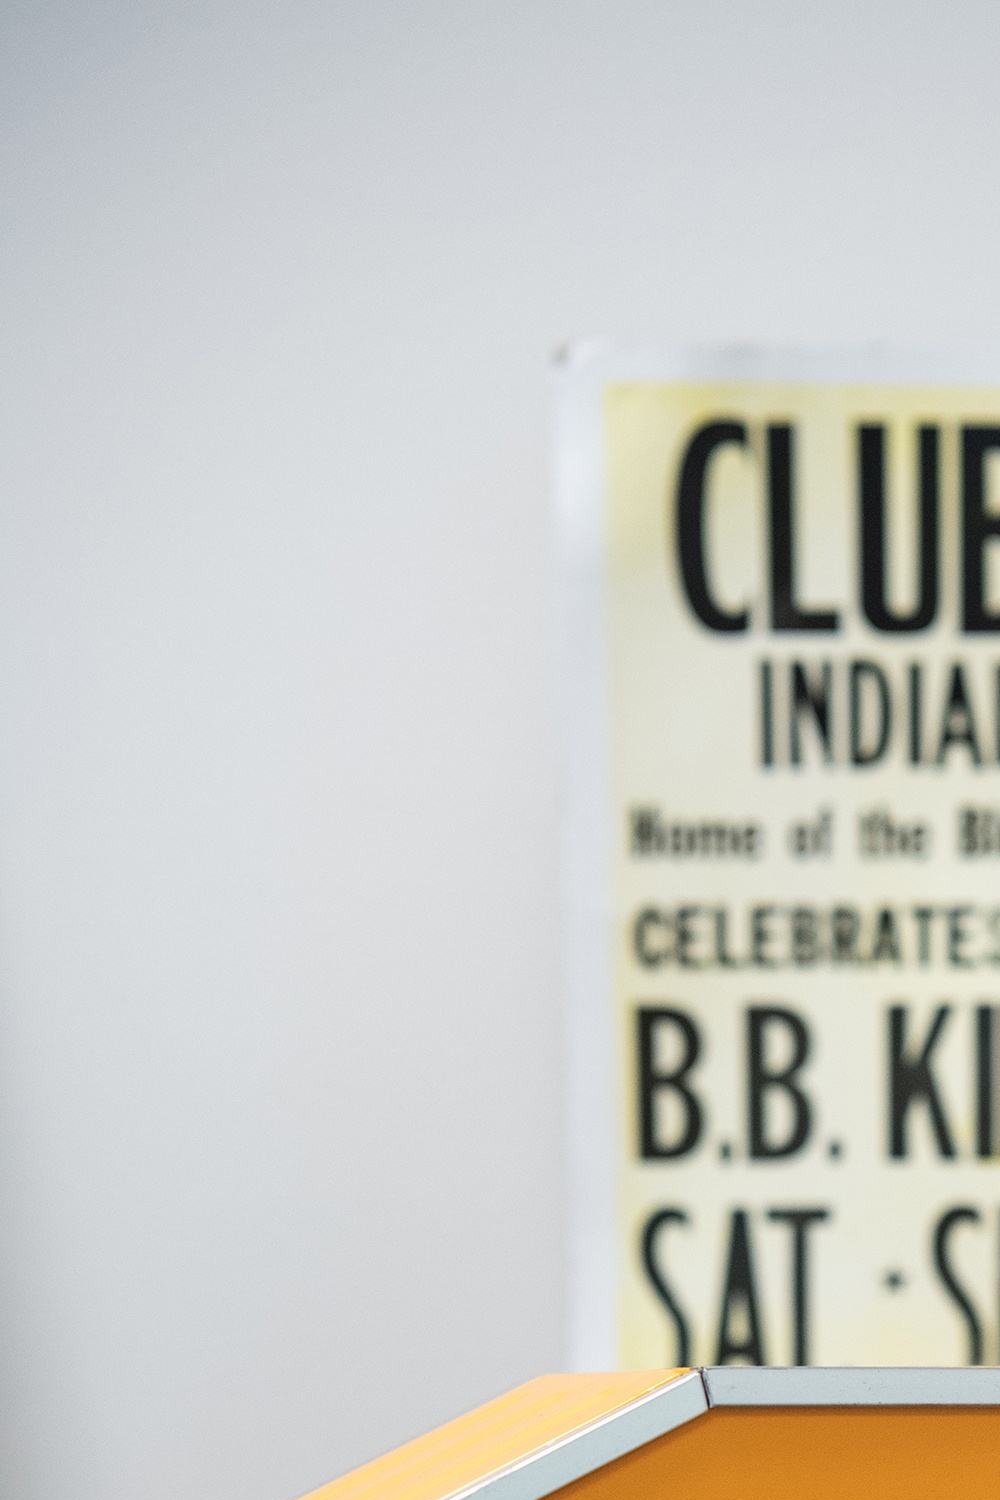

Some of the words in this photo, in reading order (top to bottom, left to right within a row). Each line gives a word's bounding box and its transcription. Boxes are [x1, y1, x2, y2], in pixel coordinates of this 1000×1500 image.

[630, 809, 759, 857] Home
[789, 810, 833, 859] of
[859, 811, 928, 858] the
[633, 1004, 840, 1164] B.B.
[638, 1206, 830, 1365] SAT
